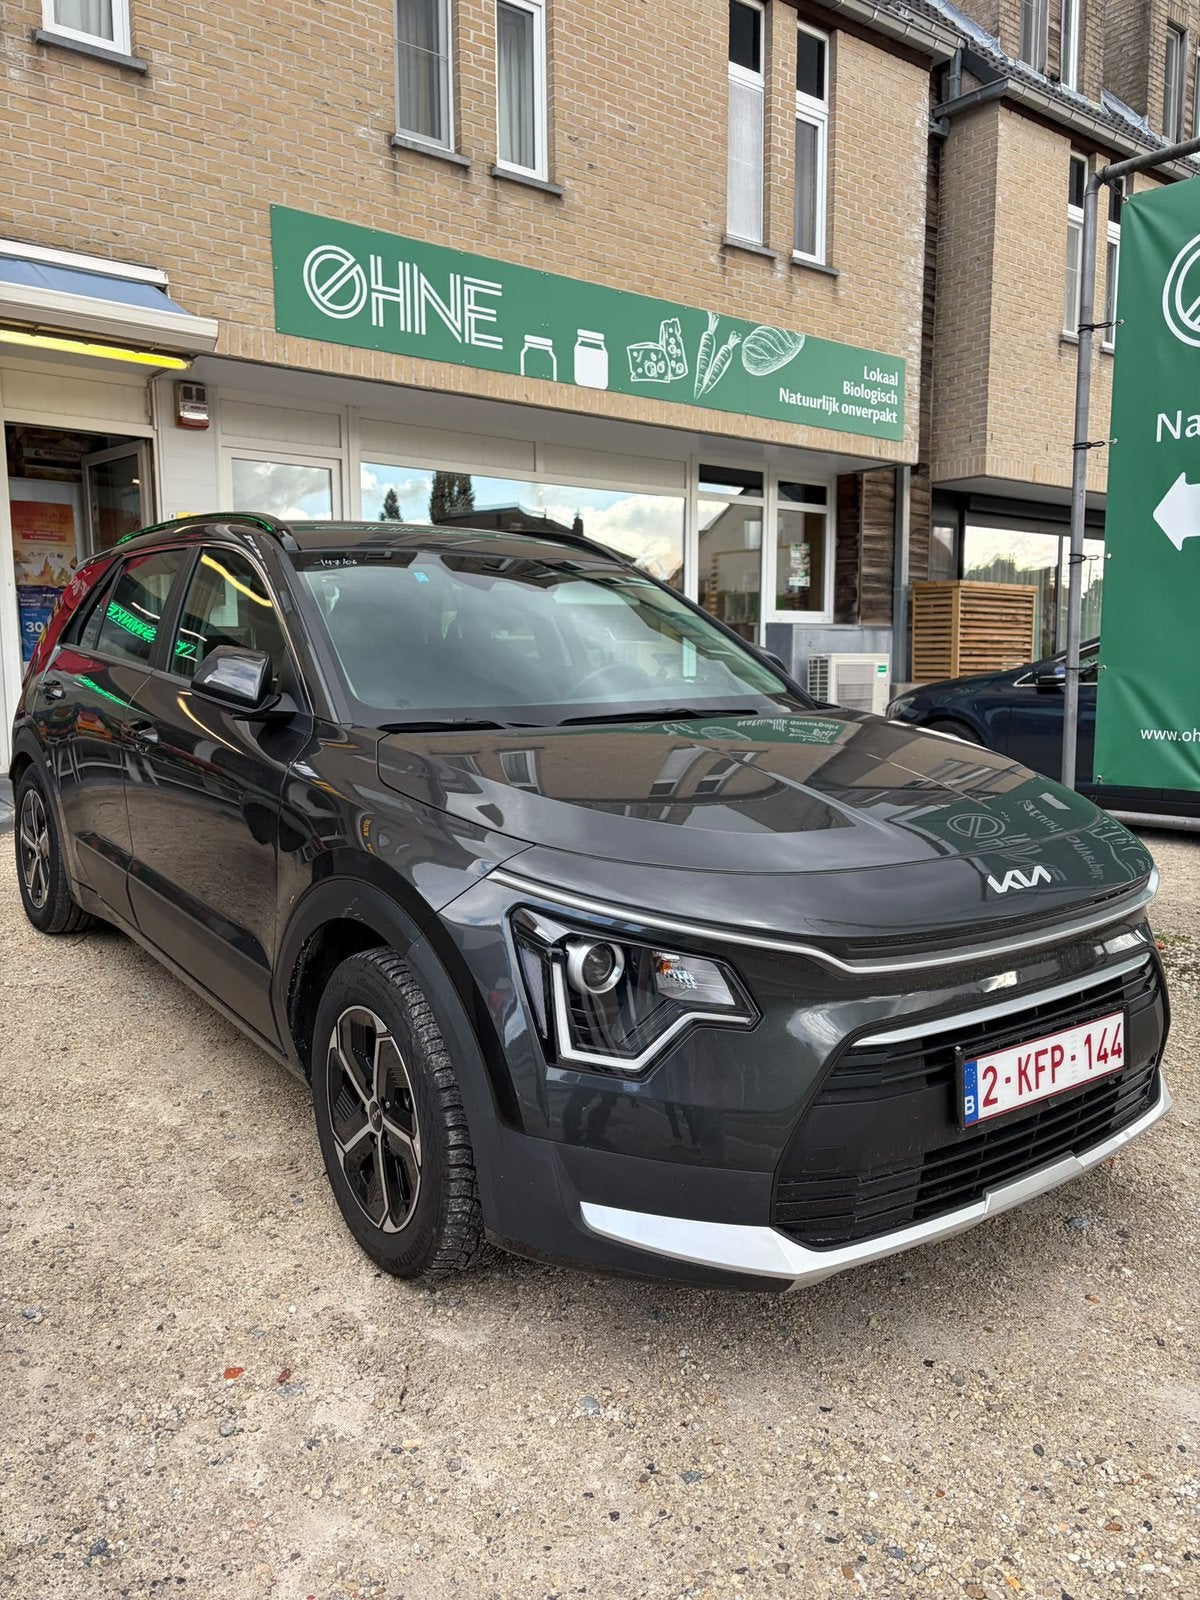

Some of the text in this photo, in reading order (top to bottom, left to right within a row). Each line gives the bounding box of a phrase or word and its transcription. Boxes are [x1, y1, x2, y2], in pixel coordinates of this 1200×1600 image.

[863, 365, 899, 386] Lokaal
[843, 380, 898, 405] Biologisch
[779, 387, 898, 424] Natuurlijk onverpakt
[26, 621, 44, 633] 30
[987, 864, 1051, 893] KIA
[982, 1022, 1123, 1108] 2-KFP-144
[964, 1095, 975, 1115] B
